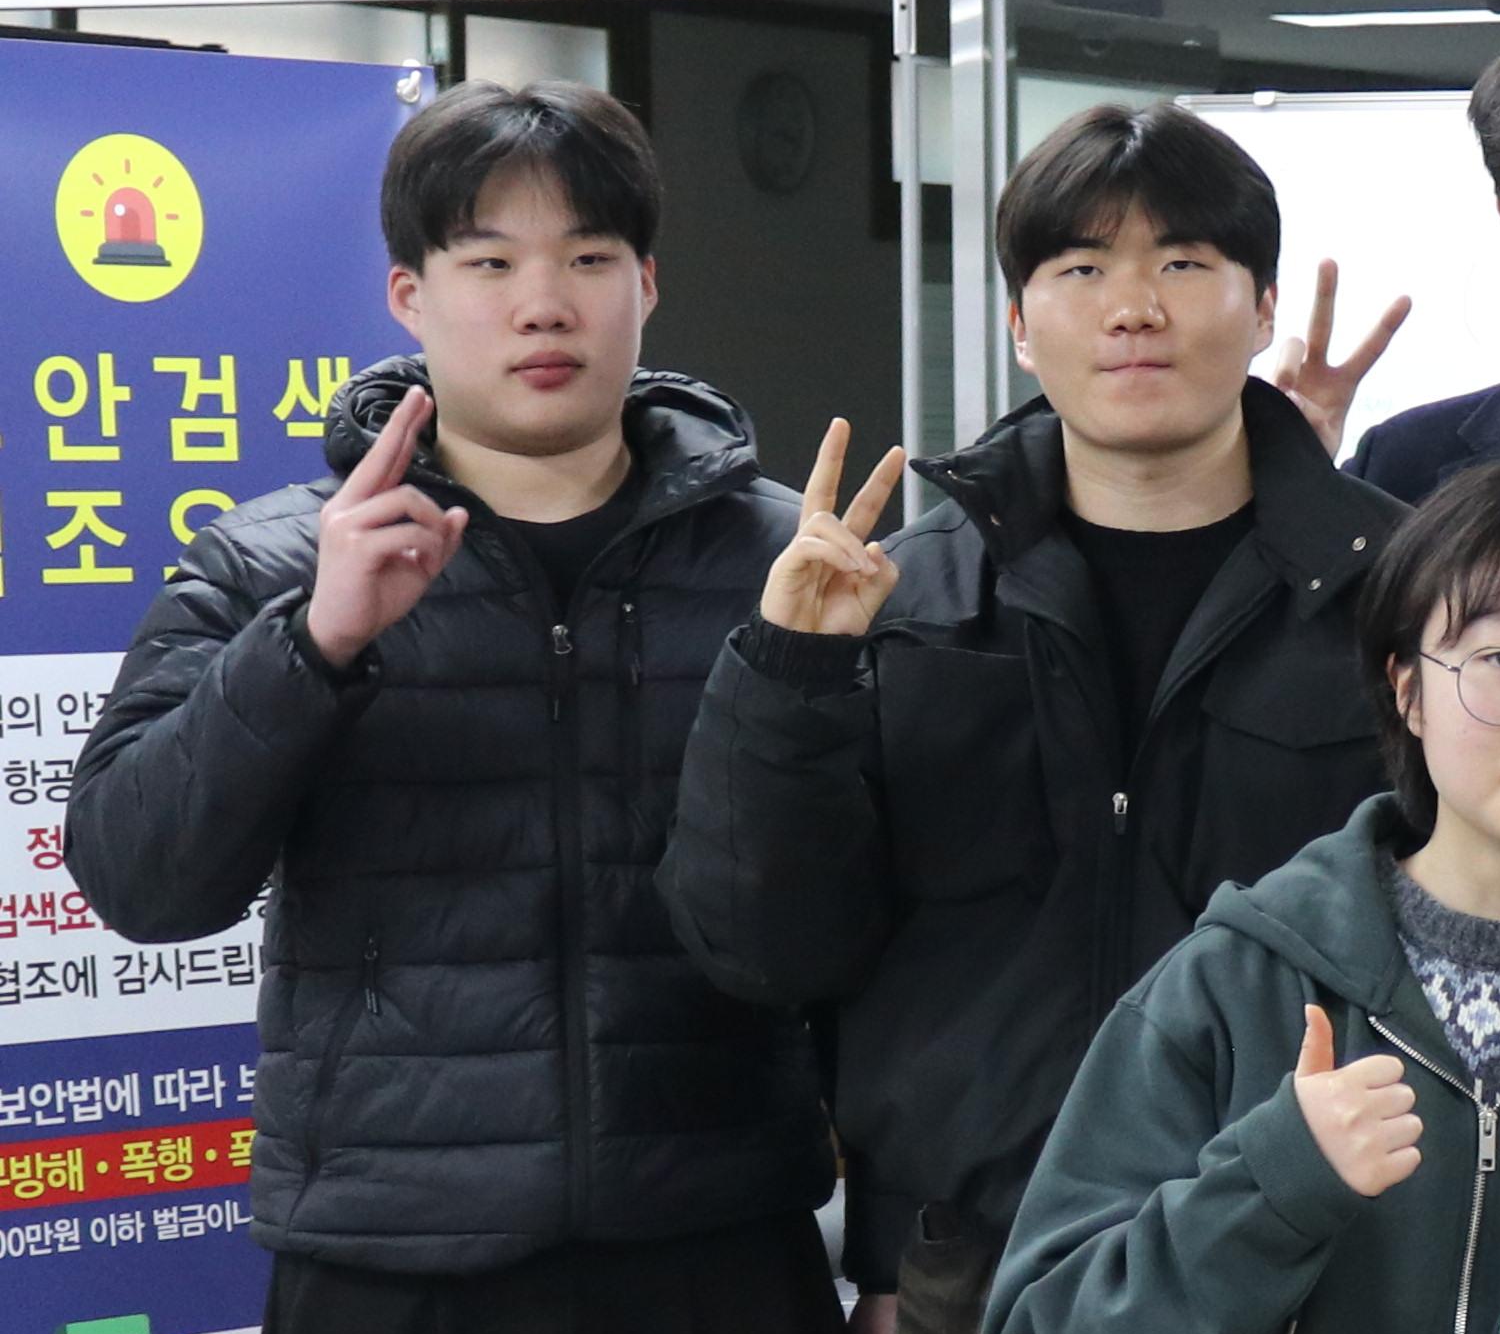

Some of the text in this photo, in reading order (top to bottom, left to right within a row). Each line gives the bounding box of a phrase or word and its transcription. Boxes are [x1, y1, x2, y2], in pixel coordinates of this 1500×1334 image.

[113, 942, 265, 997] 감사드립
[153, 1063, 227, 1113] 따라
[119, 1135, 194, 1186] 폭행
[89, 1208, 145, 1248] 이하
